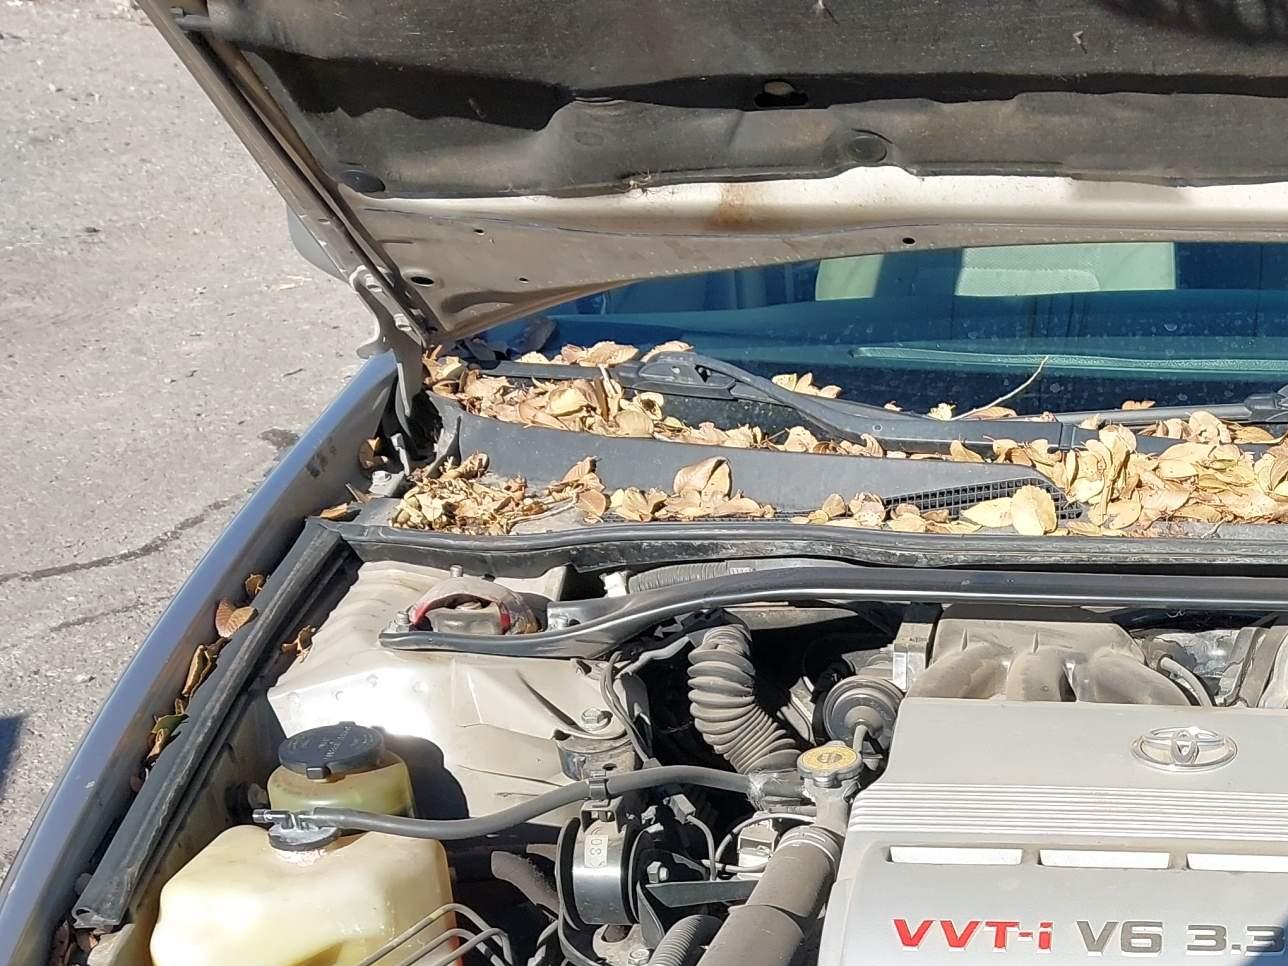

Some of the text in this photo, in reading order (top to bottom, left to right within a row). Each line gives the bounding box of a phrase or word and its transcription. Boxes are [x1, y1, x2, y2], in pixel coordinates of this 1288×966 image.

[892, 919, 1286, 954] VVT-i V6 3.3
